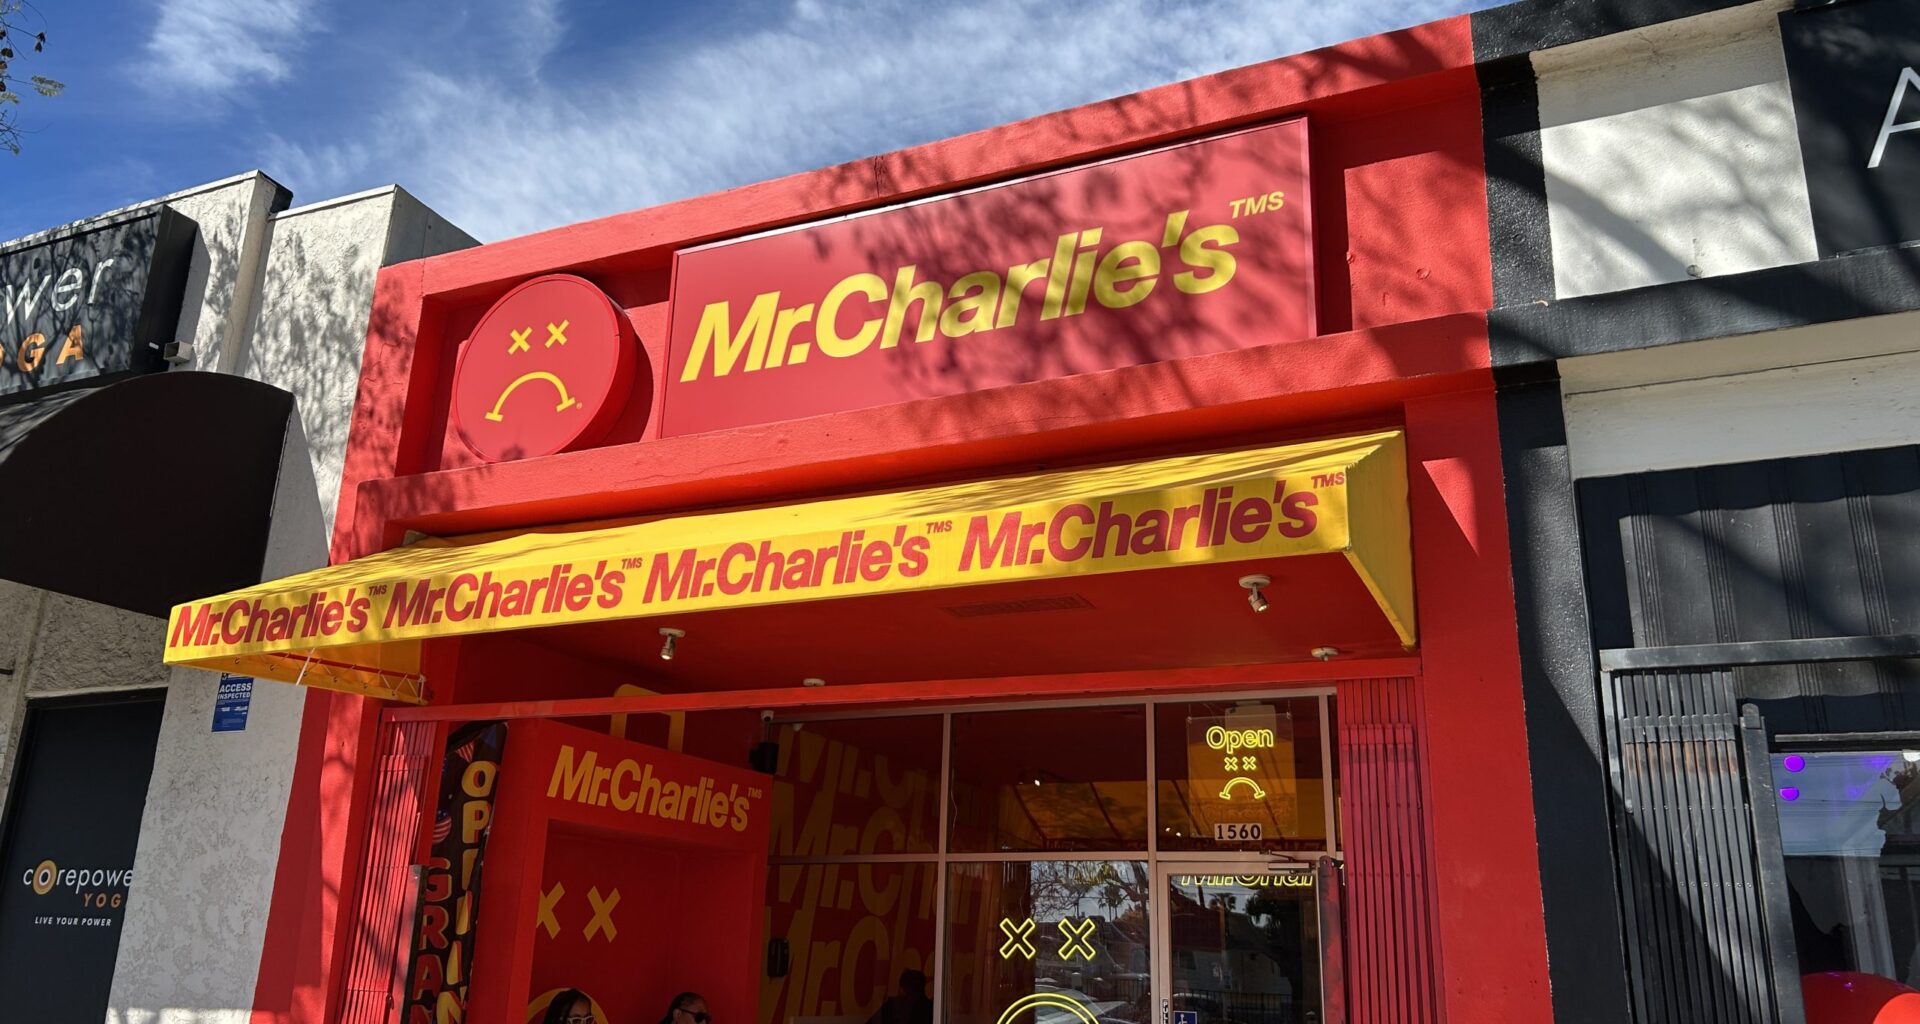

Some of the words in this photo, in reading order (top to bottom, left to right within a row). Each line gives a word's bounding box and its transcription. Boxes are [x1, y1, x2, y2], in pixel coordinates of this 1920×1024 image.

[680, 210, 1240, 383] Mr.Charlie's
[0, 323, 84, 372] GA
[169, 588, 370, 648] Mr.Charlie's
[382, 560, 626, 629] Mr.Charlie's
[642, 525, 931, 604] Mr.Charlie's
[958, 480, 1319, 572] Mr.Charlie's
[217, 692, 251, 700] INSPECTED
[220, 683, 252, 693] ACCESS
[1206, 725, 1274, 754] Open
[546, 744, 750, 832] Mr.Charlie's
[1217, 825, 1261, 839] 1560
[35, 916, 53, 925] LIVE
[56, 917, 78, 926] YOUR
[81, 918, 111, 926] POWER
